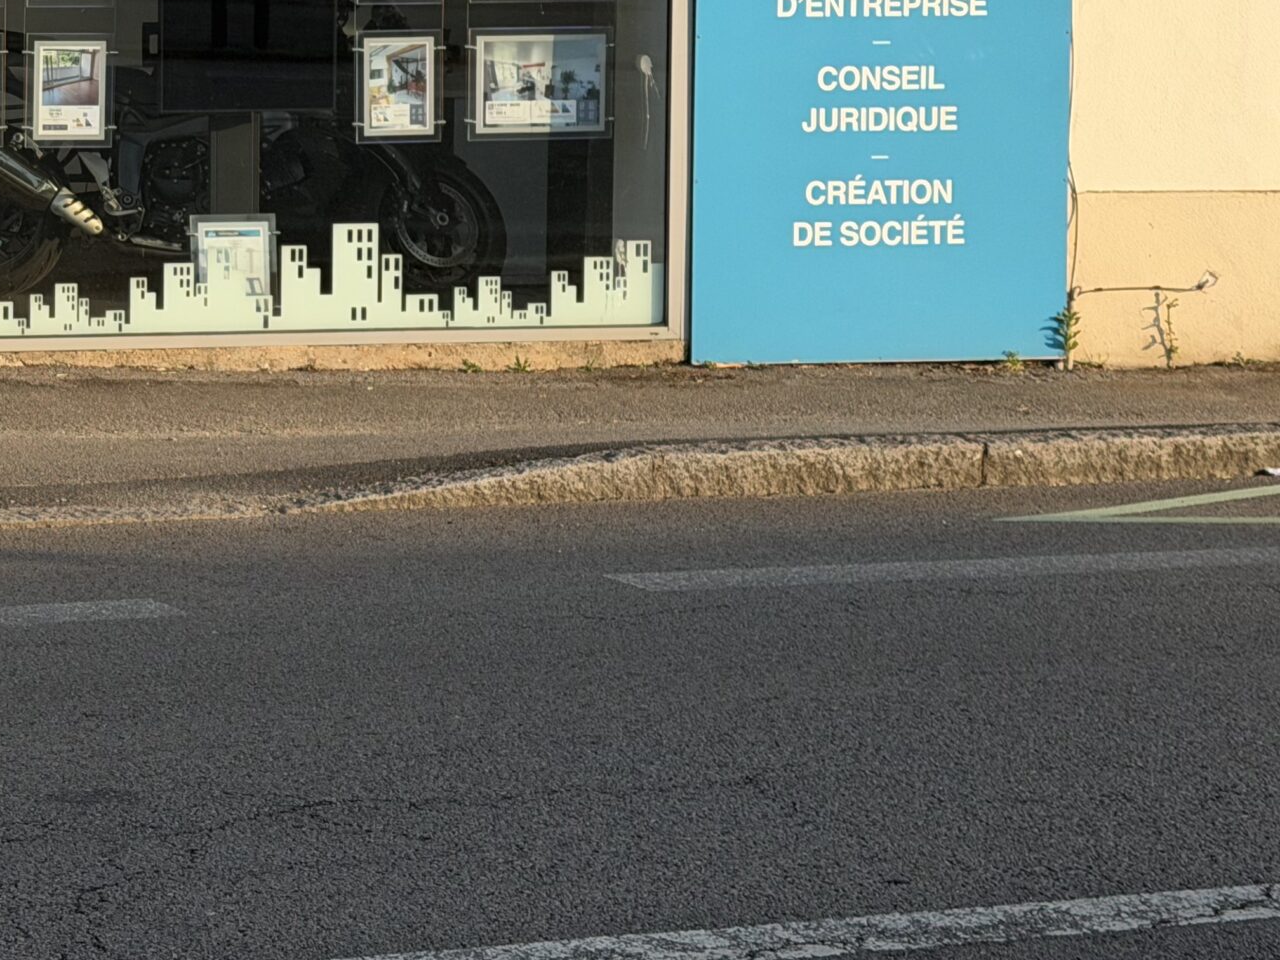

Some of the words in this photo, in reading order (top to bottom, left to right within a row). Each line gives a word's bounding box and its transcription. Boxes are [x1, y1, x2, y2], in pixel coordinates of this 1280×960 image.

[817, 65, 945, 91] CONSEIL
[801, 106, 958, 132] JURIDIQUE
[805, 174, 953, 205] CRÉATION
[793, 222, 833, 247] DE
[840, 213, 965, 247] SOCIÉTÉ
